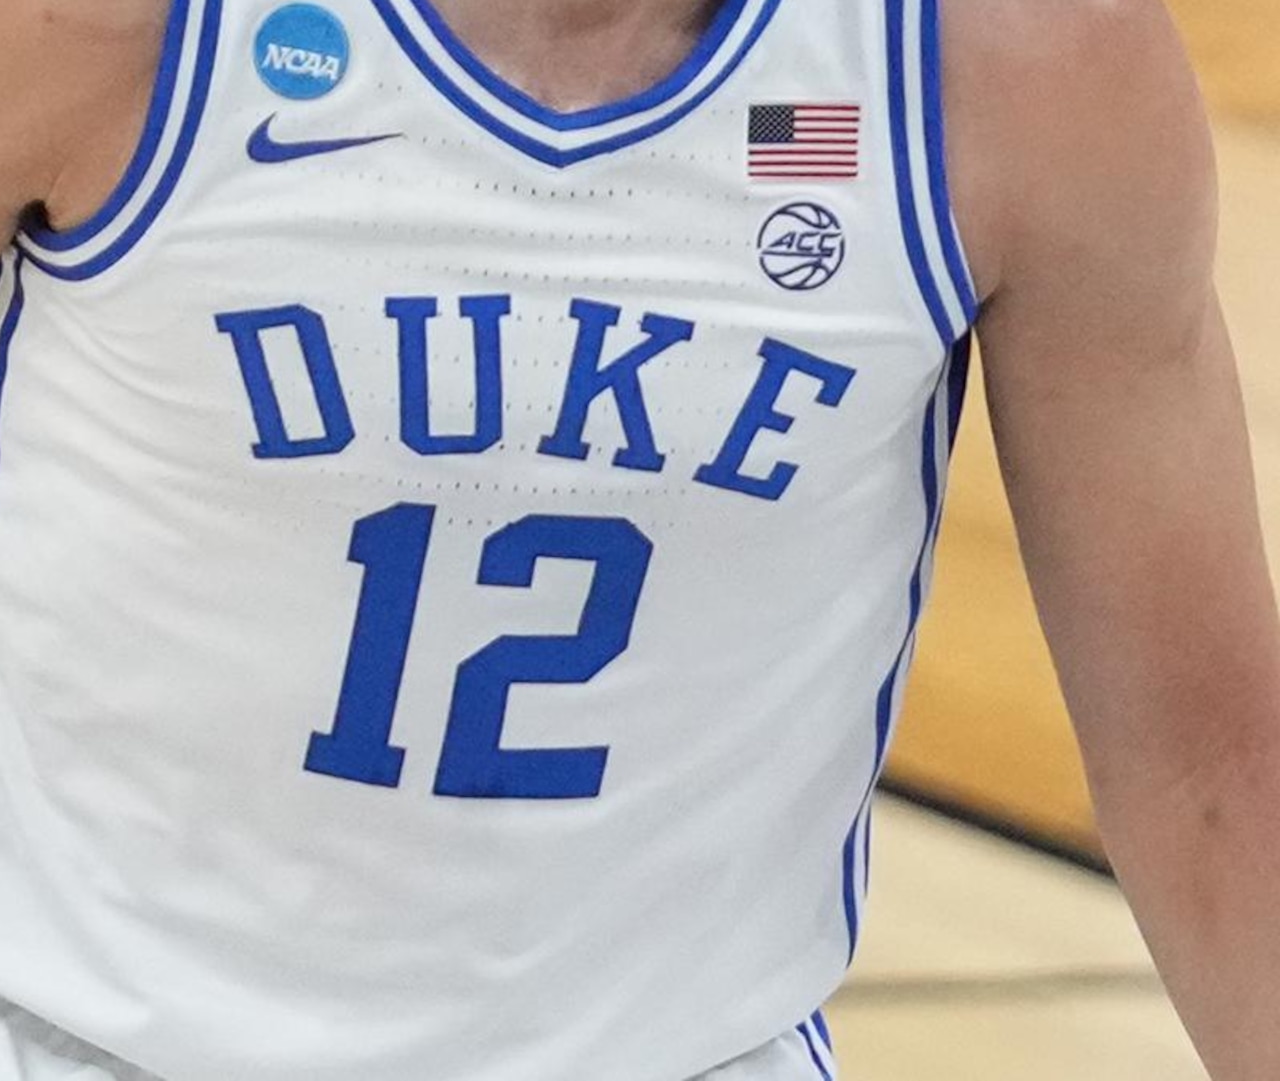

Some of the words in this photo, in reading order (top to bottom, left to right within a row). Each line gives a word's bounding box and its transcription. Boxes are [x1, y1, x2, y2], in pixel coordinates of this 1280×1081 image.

[260, 42, 341, 81] NCAA
[767, 230, 842, 258] ACC
[213, 293, 856, 501] DUKE
[303, 501, 654, 799] 12
